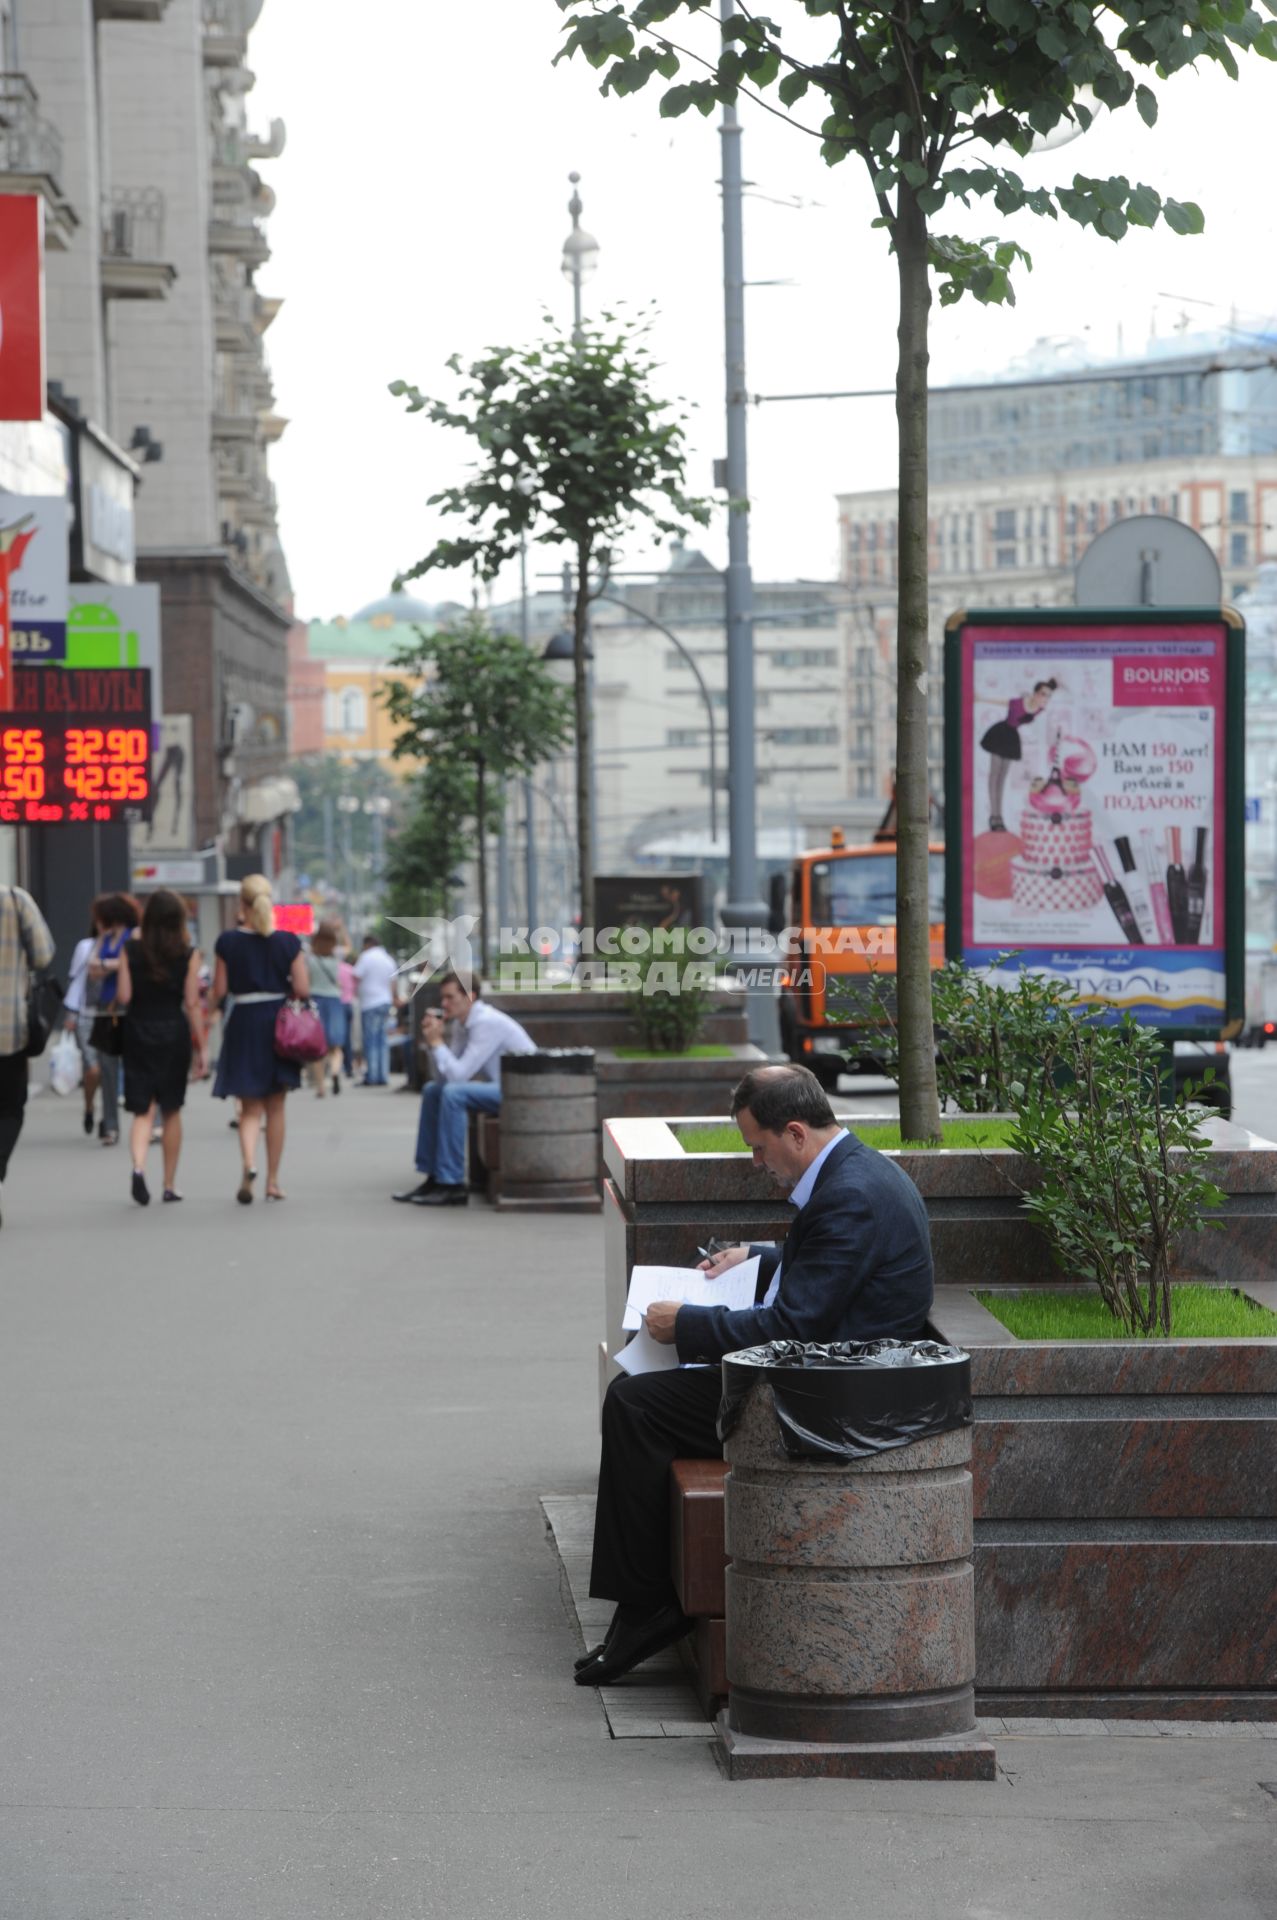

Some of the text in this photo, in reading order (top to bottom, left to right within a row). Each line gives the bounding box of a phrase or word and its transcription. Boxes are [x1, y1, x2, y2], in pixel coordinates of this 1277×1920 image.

[1123, 667, 1210, 685] BOURJOIS
[44, 671, 145, 712] ВАЛЮТЫ
[65, 729, 147, 764] 32.90
[1102, 742, 1146, 757] НАМ
[1151, 742, 1177, 757] 150
[1113, 760, 1194, 775] Вам до 150
[63, 766, 148, 800] 42.95
[1122, 777, 1172, 792] рублей
